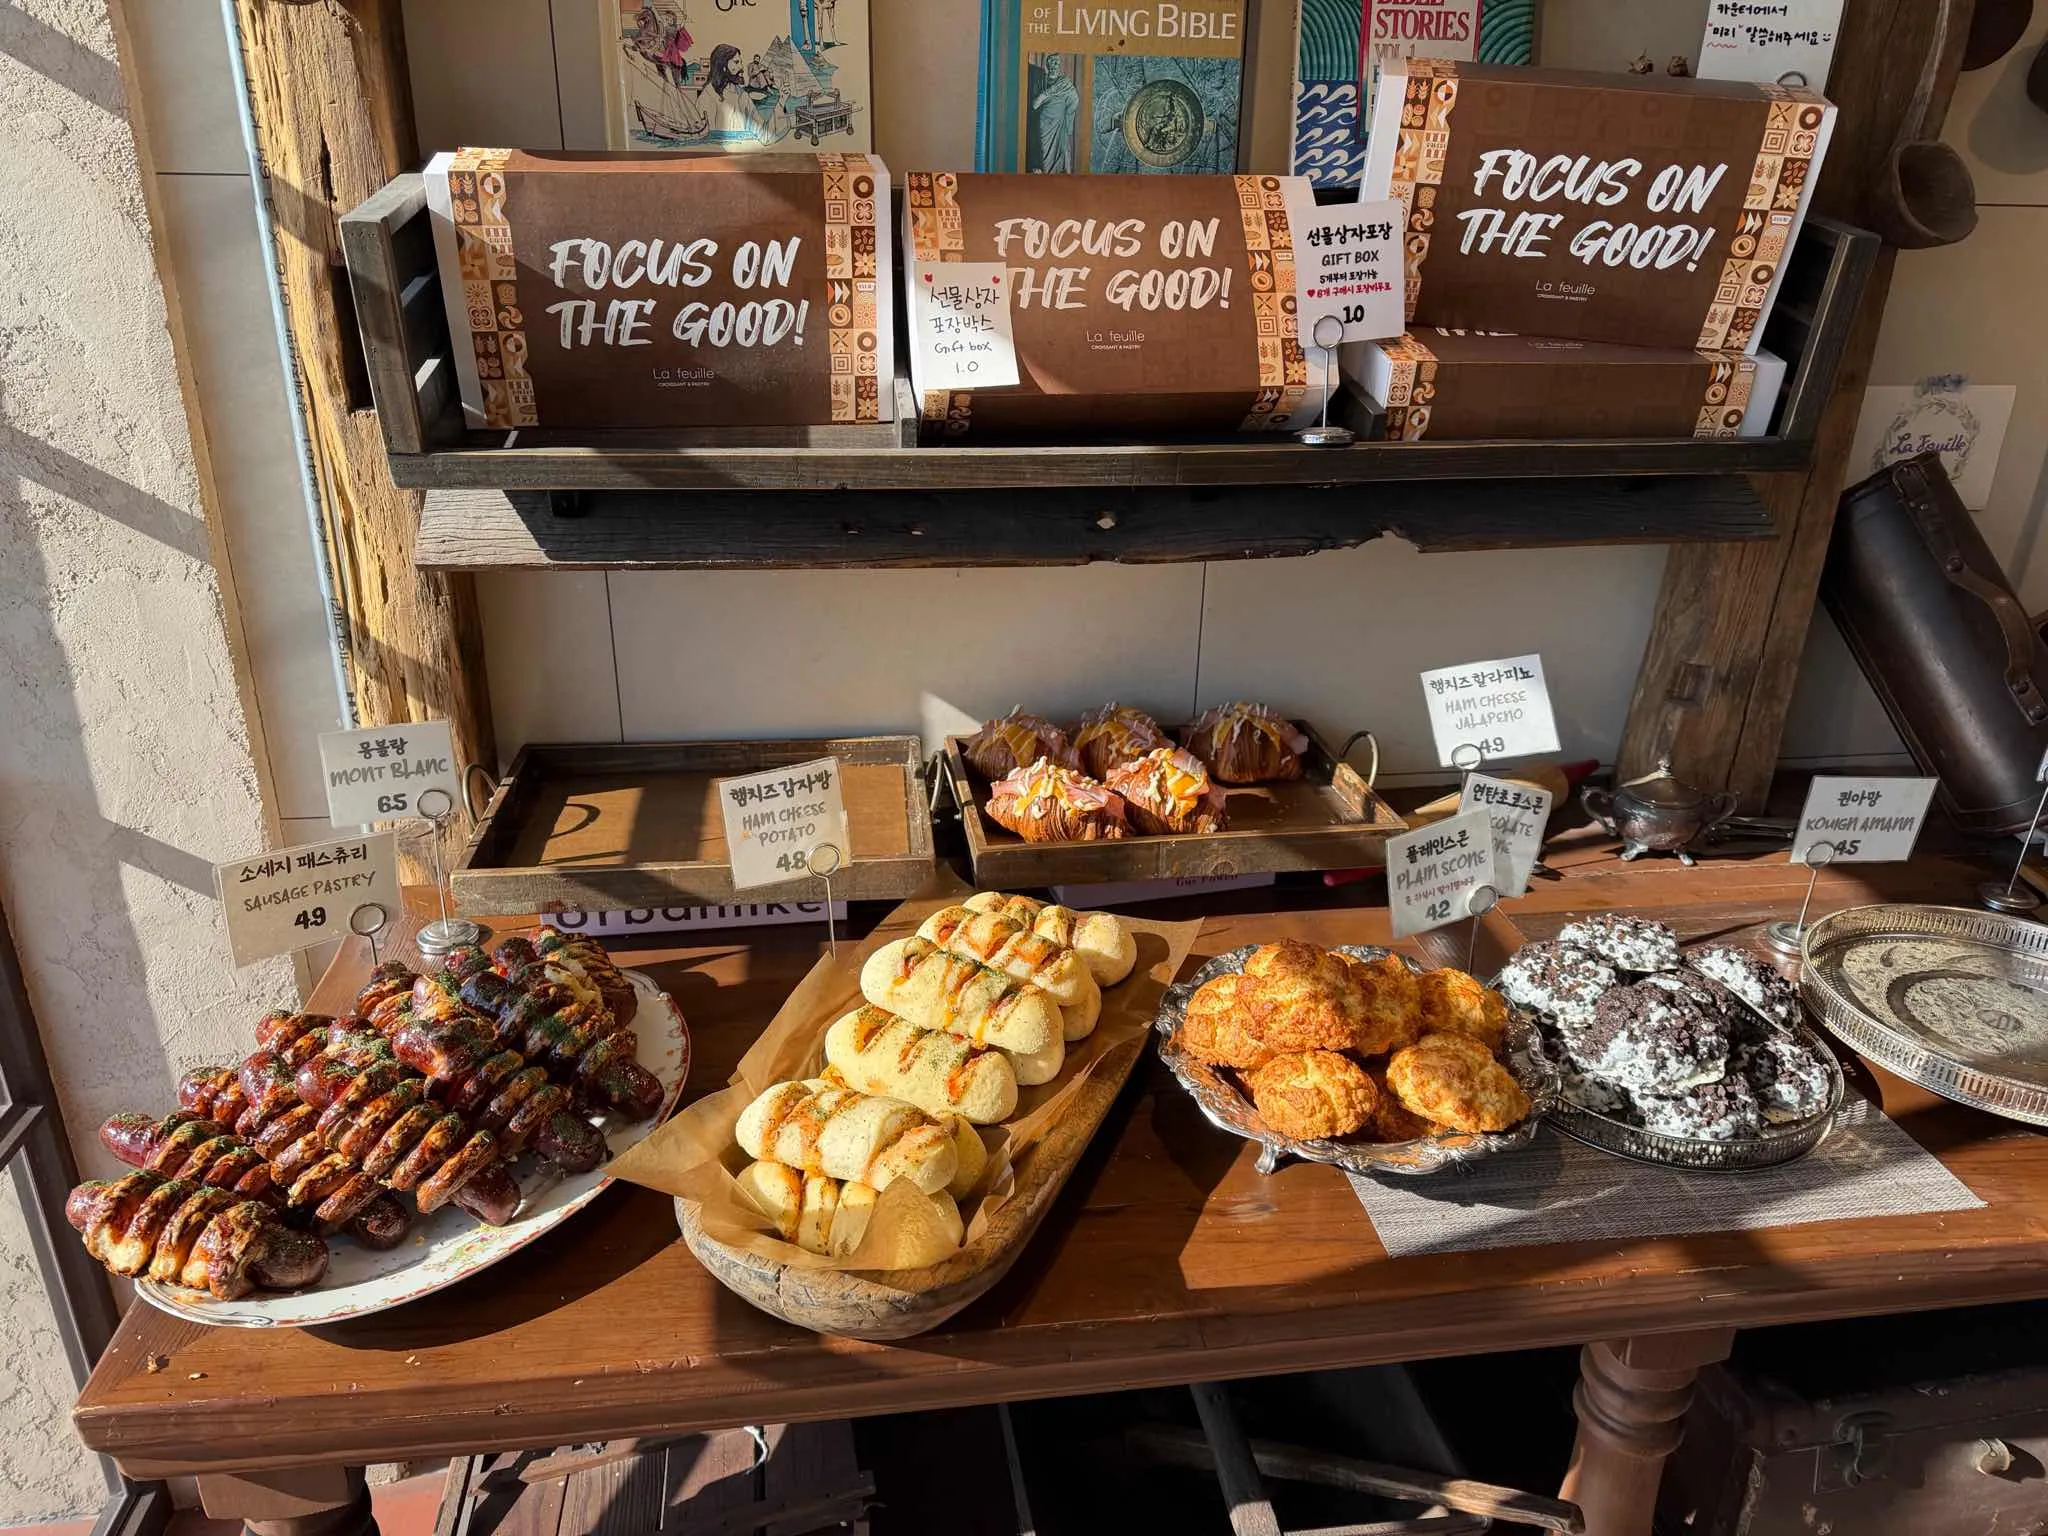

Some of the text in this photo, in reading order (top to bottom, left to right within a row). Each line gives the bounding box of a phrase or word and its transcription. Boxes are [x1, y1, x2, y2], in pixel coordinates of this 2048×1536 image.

[1032, 8, 1051, 19] OF
[1056, 0, 1237, 40] LIVING BIBLE
[1717, 2, 1788, 17] 카운터에서
[1028, 24, 1051, 34] THE
[1374, 9, 1470, 41] STORIES
[1473, 149, 1728, 214] FOCUS ON
[993, 216, 1220, 259] FOCUS ON
[1456, 208, 1716, 273] THE GOOD!
[549, 236, 801, 290] FOCUS ON
[1322, 249, 1380, 267] GIFT BOX
[929, 285, 1001, 311] 선물상자
[1105, 267, 1233, 311] GOOD!
[1535, 279, 1596, 295] La feuille
[545, 299, 809, 350] THE GOOD!
[928, 313, 995, 334] 포장박스
[1086, 330, 1145, 342] La feuille
[968, 341, 993, 353] box
[652, 367, 715, 380] La feuille
[1444, 690, 1528, 714] HAM CHEESE
[1455, 708, 1524, 730] JALAPENO
[357, 736, 410, 760] 몽블랑
[330, 757, 450, 788] MONT BLANC
[742, 800, 827, 831] HAM CHEESE
[1805, 815, 1916, 833] KOUIGN AMANN
[758, 822, 816, 847] POTATO
[239, 843, 368, 883] 소세지 패스츄리
[1396, 862, 1439, 891] PLAIN
[1441, 848, 1489, 878] SCONE
[243, 870, 377, 913] SAUSAGE PASTRY
